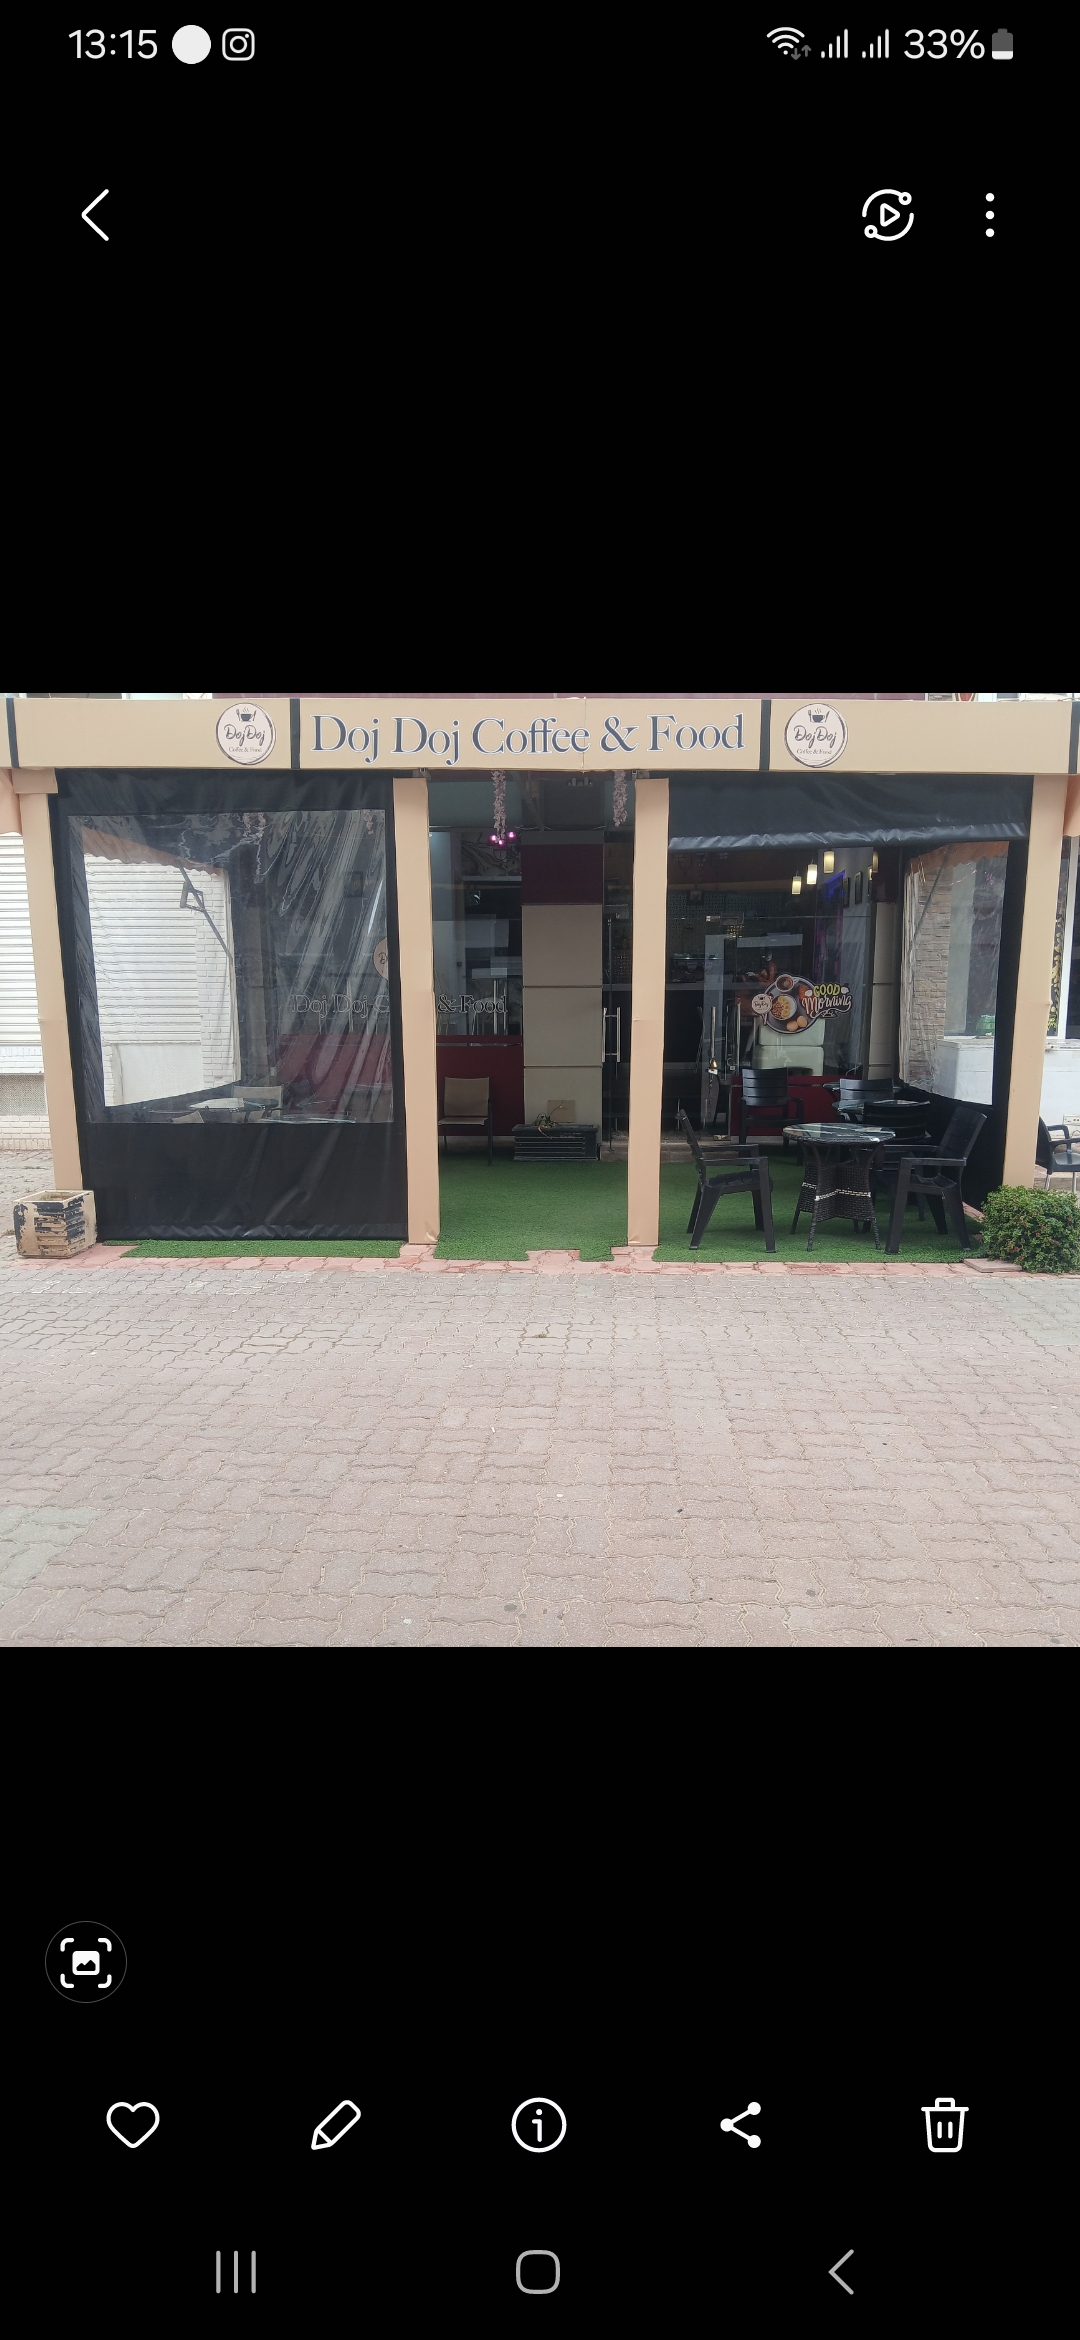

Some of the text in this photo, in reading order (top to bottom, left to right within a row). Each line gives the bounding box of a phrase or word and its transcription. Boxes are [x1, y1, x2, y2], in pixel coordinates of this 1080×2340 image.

[309, 712, 746, 766] Doj Doj Coffee & Food
[812, 983, 841, 997] GOOD
[291, 994, 328, 1019] Doj
[332, 994, 369, 1019] Doj
[437, 994, 456, 1013] &
[458, 994, 508, 1013] Food
[802, 994, 852, 1016] Morning
